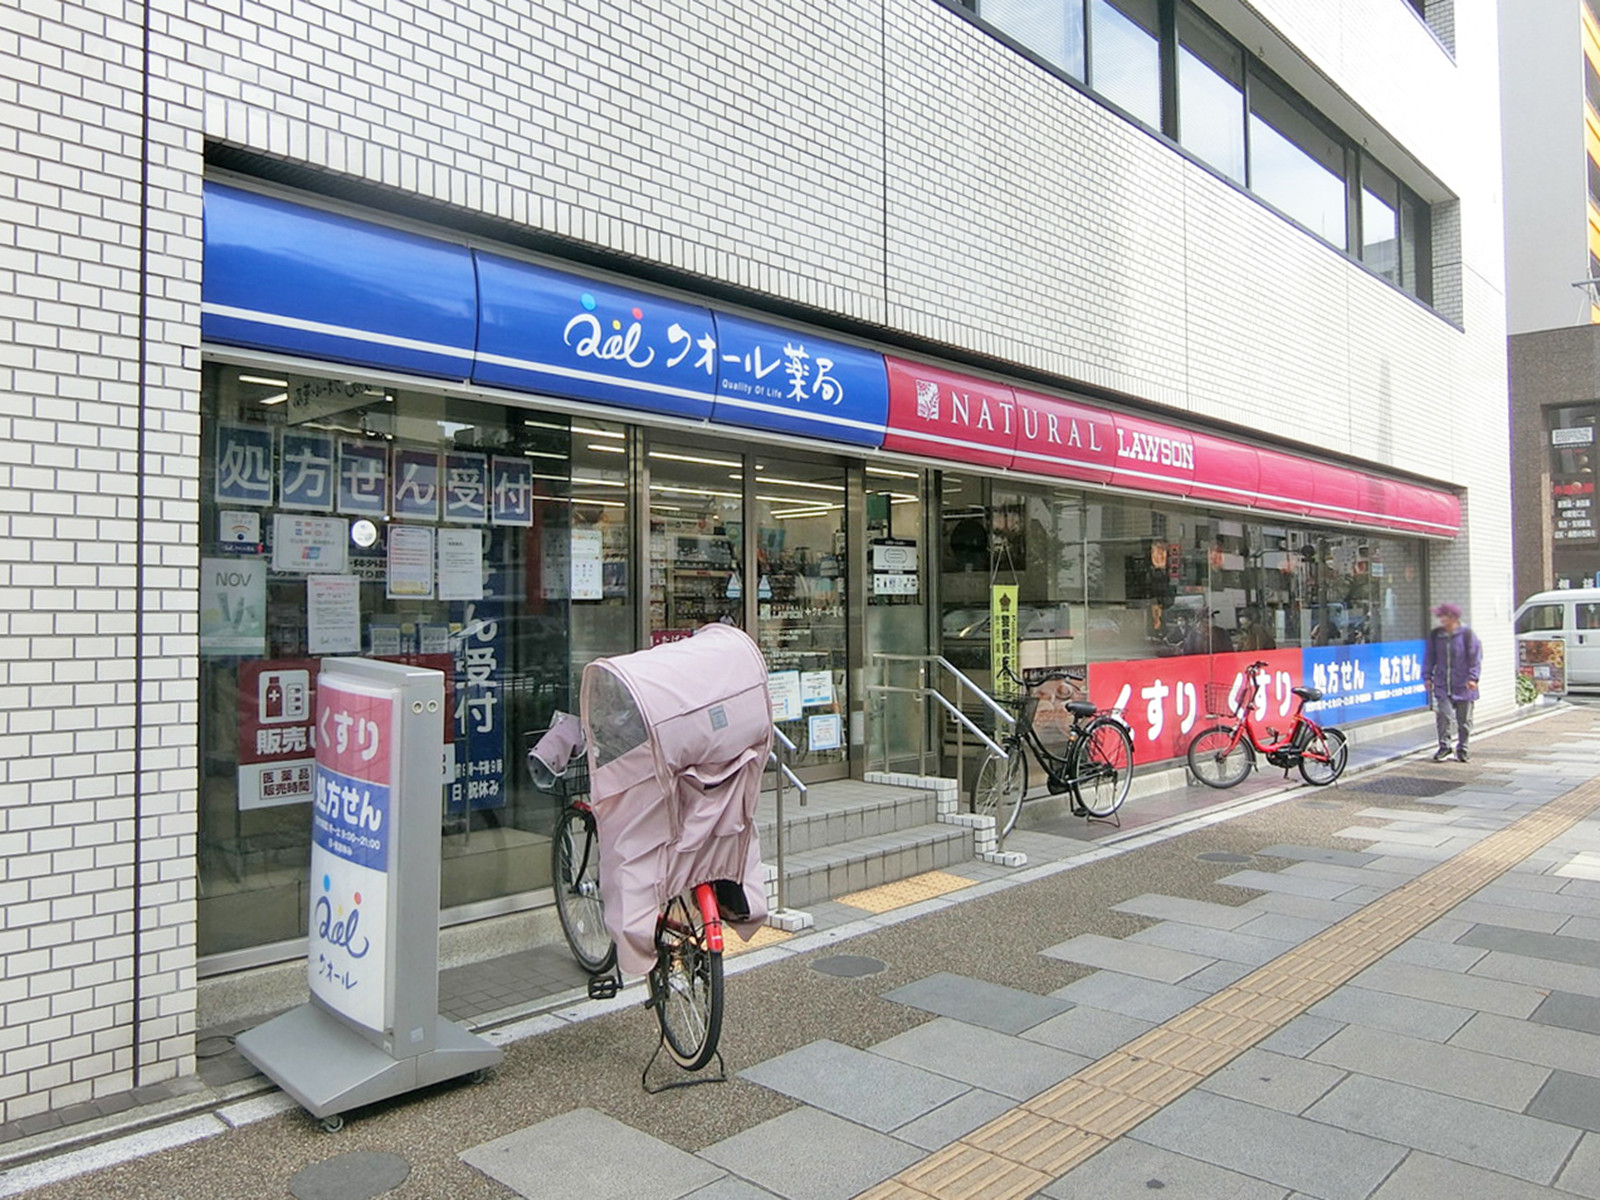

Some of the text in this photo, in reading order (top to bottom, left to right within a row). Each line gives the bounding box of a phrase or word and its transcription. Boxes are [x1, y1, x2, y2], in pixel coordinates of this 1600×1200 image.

[667, 323, 843, 405] クオール薬局
[722, 378, 782, 399] Quality Of Life
[951, 391, 1194, 470] NATURAL LAWSON
[219, 439, 531, 514] 処方せん受付
[215, 572, 252, 587] NOV
[1227, 669, 1293, 722] くすり
[1312, 659, 1365, 694] 処方せん
[1380, 653, 1422, 685] 処方せん
[319, 705, 380, 761] くすり
[316, 772, 382, 832] 処方せん
[318, 954, 358, 990] クオール
